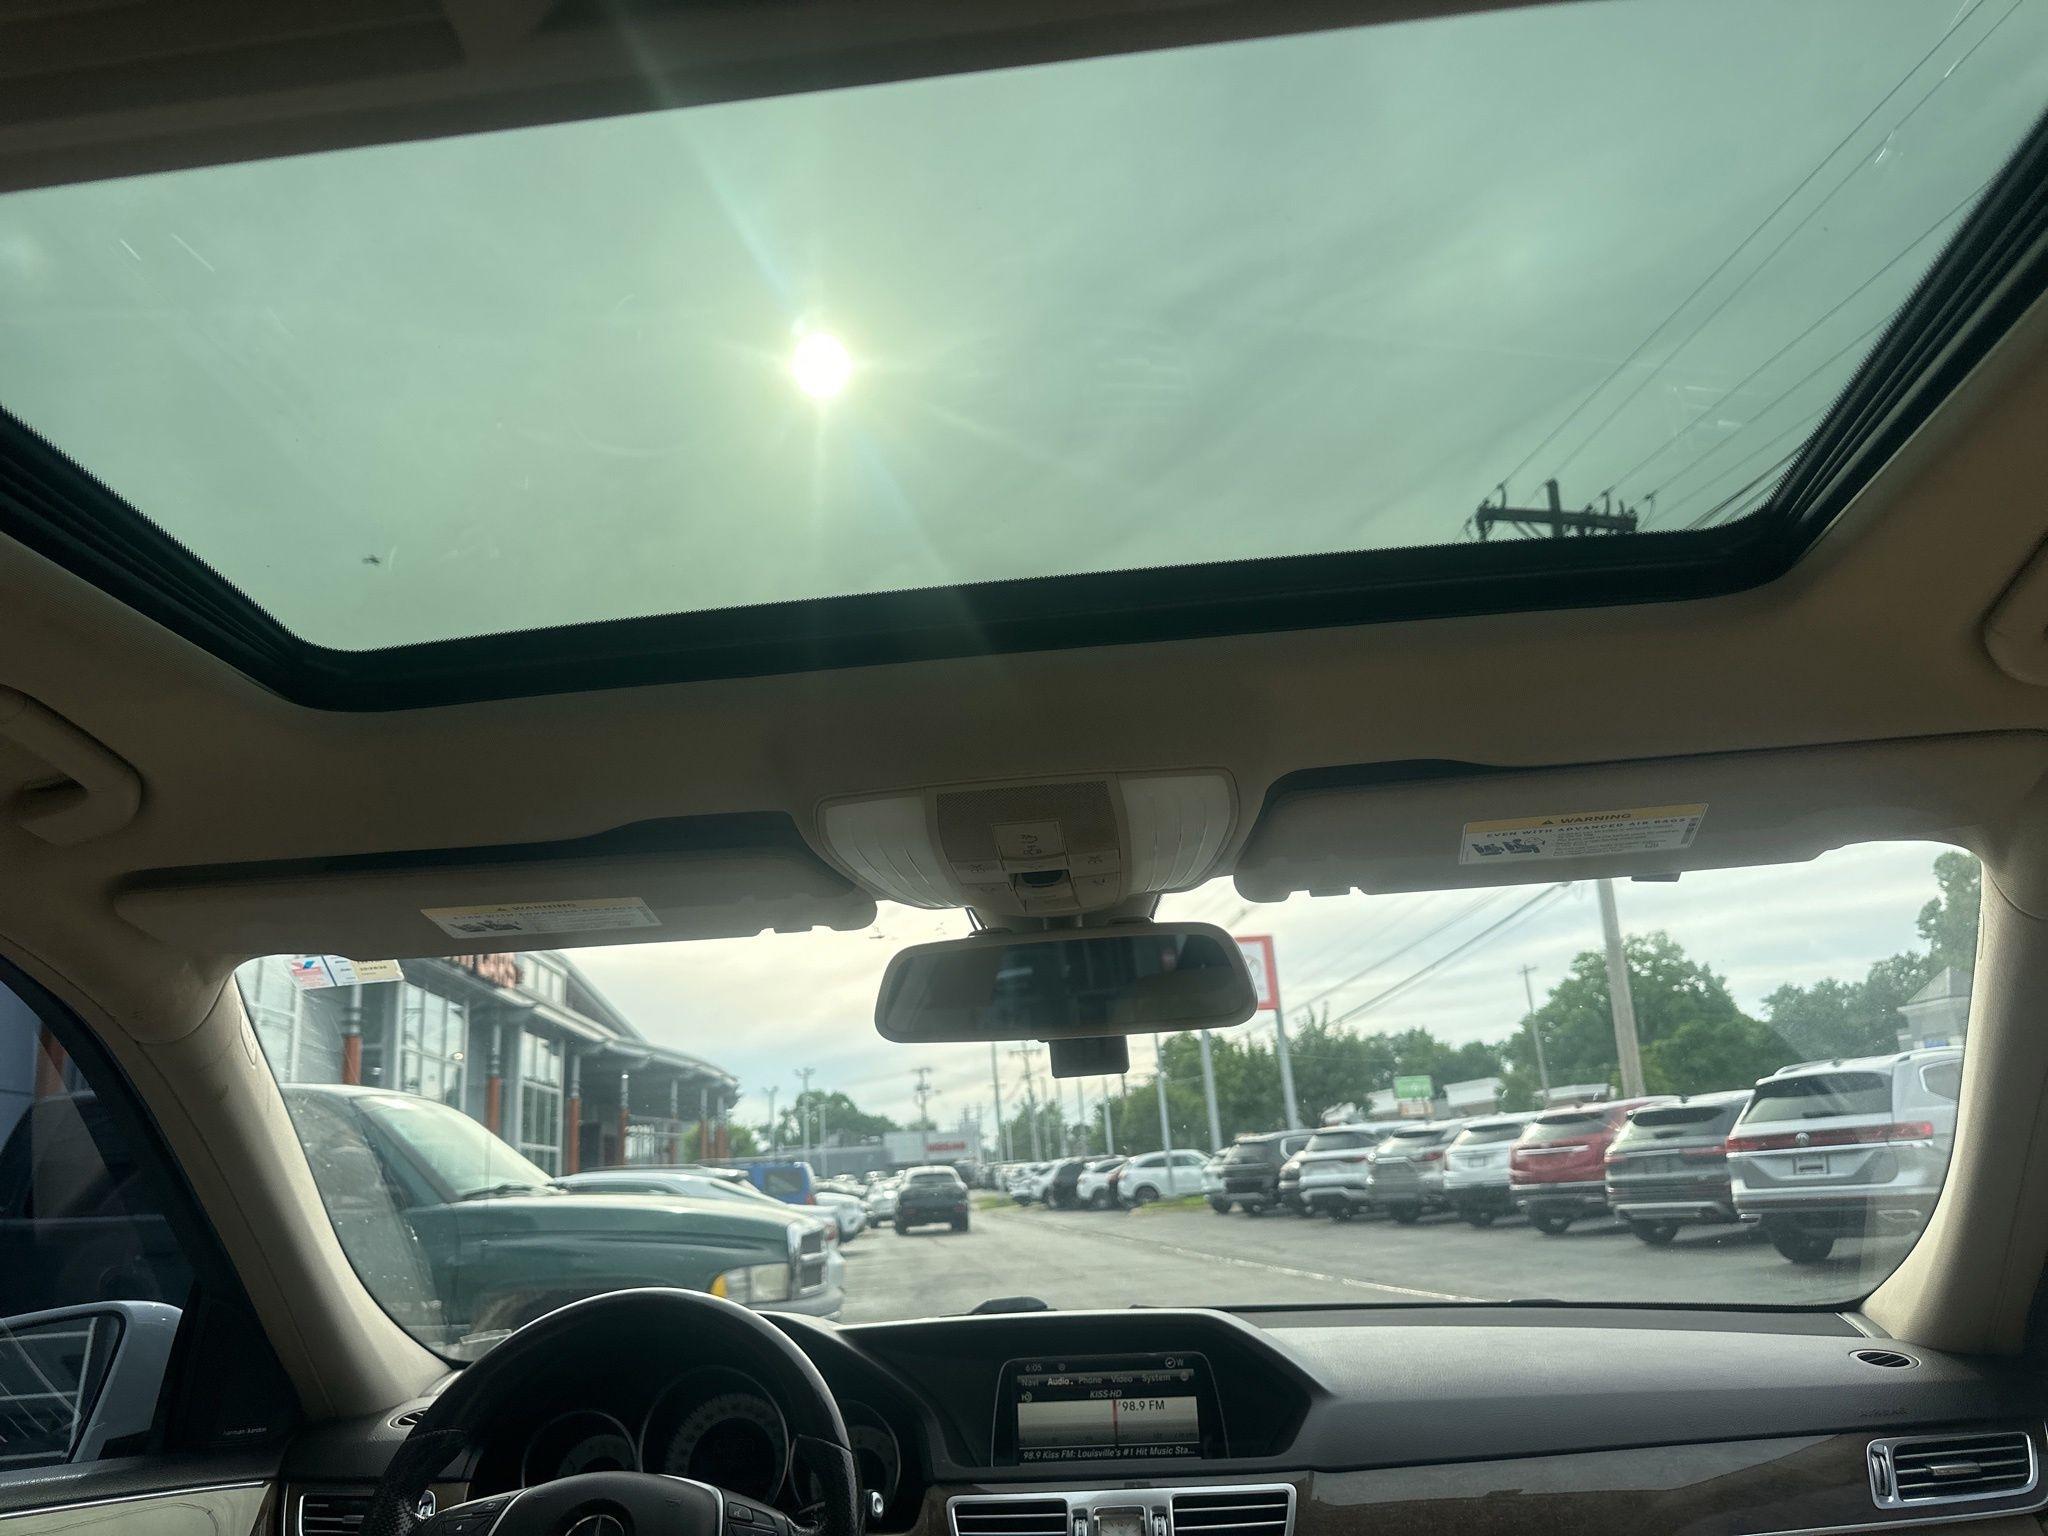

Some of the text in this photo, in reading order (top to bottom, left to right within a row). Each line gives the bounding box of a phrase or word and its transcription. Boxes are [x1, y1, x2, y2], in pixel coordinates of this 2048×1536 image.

[1560, 813, 1632, 824] WARNING
[1558, 821, 1624, 832] ADVANCED
[1047, 1377, 1069, 1386] Audio
[1078, 1376, 1102, 1385] Phone
[1111, 1374, 1133, 1383] Video
[1142, 1373, 1171, 1383] System
[1122, 1400, 1165, 1411] 98.9 FM
[1023, 1450, 1041, 1460] 98.9
[1043, 1449, 1060, 1459] Kiss
[1061, 1448, 1075, 1458] FM:
[1077, 1447, 1121, 1457] Louisville's
[1123, 1447, 1135, 1456] #1
[1136, 1447, 1148, 1455] Hit
[1150, 1446, 1174, 1455] Music
